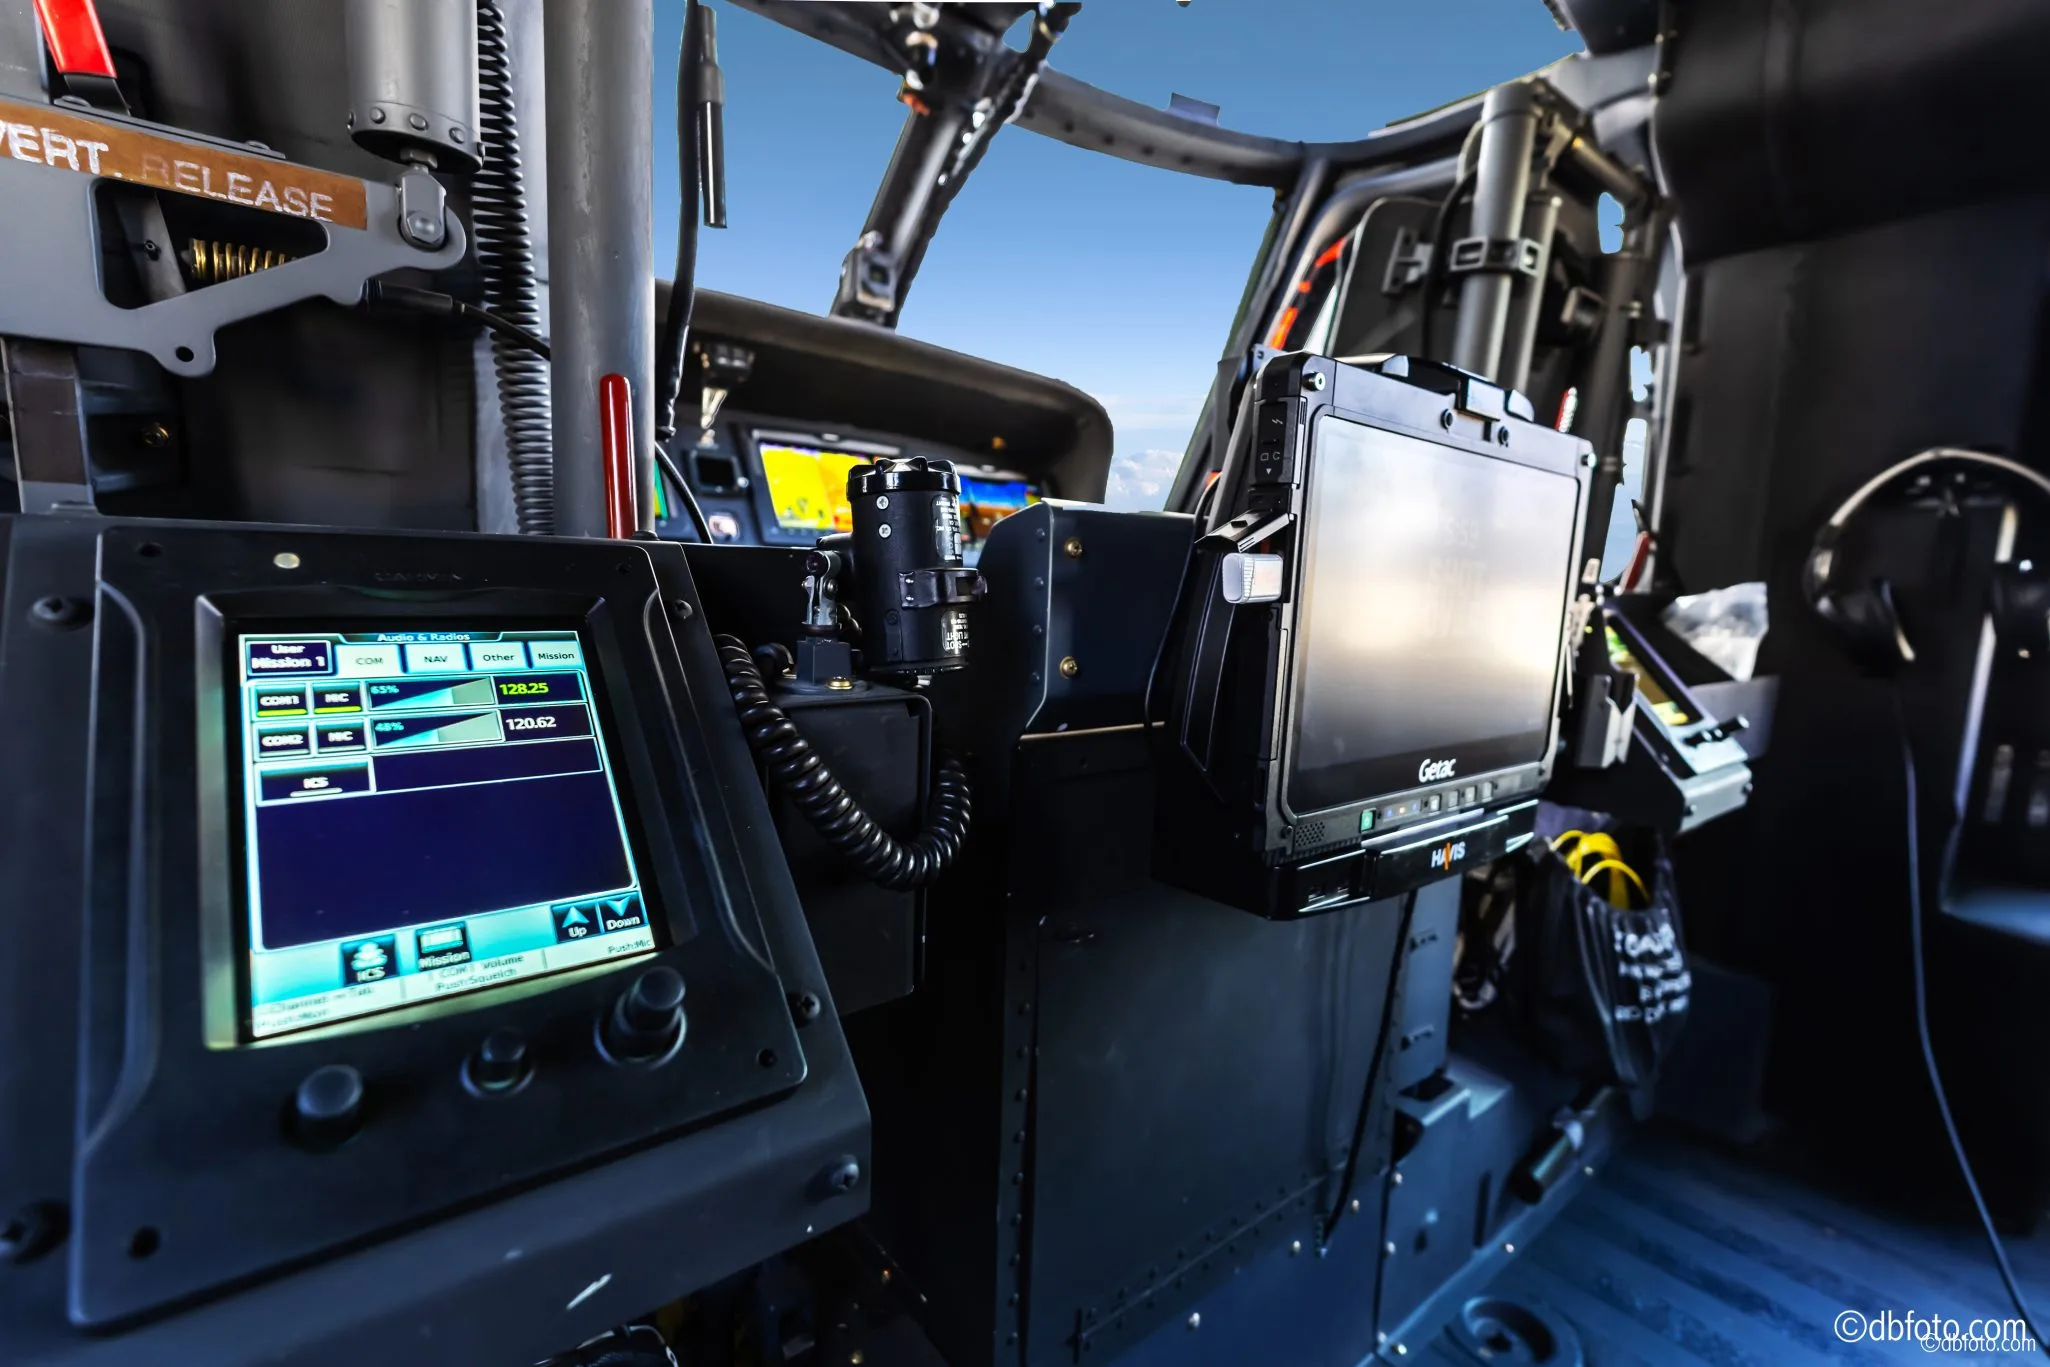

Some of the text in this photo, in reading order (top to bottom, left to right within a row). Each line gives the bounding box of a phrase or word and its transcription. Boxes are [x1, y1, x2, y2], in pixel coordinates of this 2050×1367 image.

[143, 153, 334, 222] RELEASE
[377, 631, 471, 642] Audio & Radios
[270, 643, 306, 655] User
[537, 651, 576, 661] Mission
[251, 655, 326, 670] Mission 1
[355, 656, 384, 666] COM
[423, 655, 449, 664] NAV
[482, 653, 516, 662] Other
[499, 682, 550, 696] 128.25
[259, 694, 300, 707] COM1
[324, 692, 350, 704] MIC
[505, 715, 558, 732] 120.62
[327, 730, 354, 743] MIC
[1418, 758, 1457, 783] Getac
[302, 775, 330, 790] ICS
[1430, 841, 1467, 870] HAVIS
[605, 914, 641, 932] Down
[568, 925, 588, 939] Up
[418, 950, 471, 969] Mission
[356, 966, 386, 983] ICS
